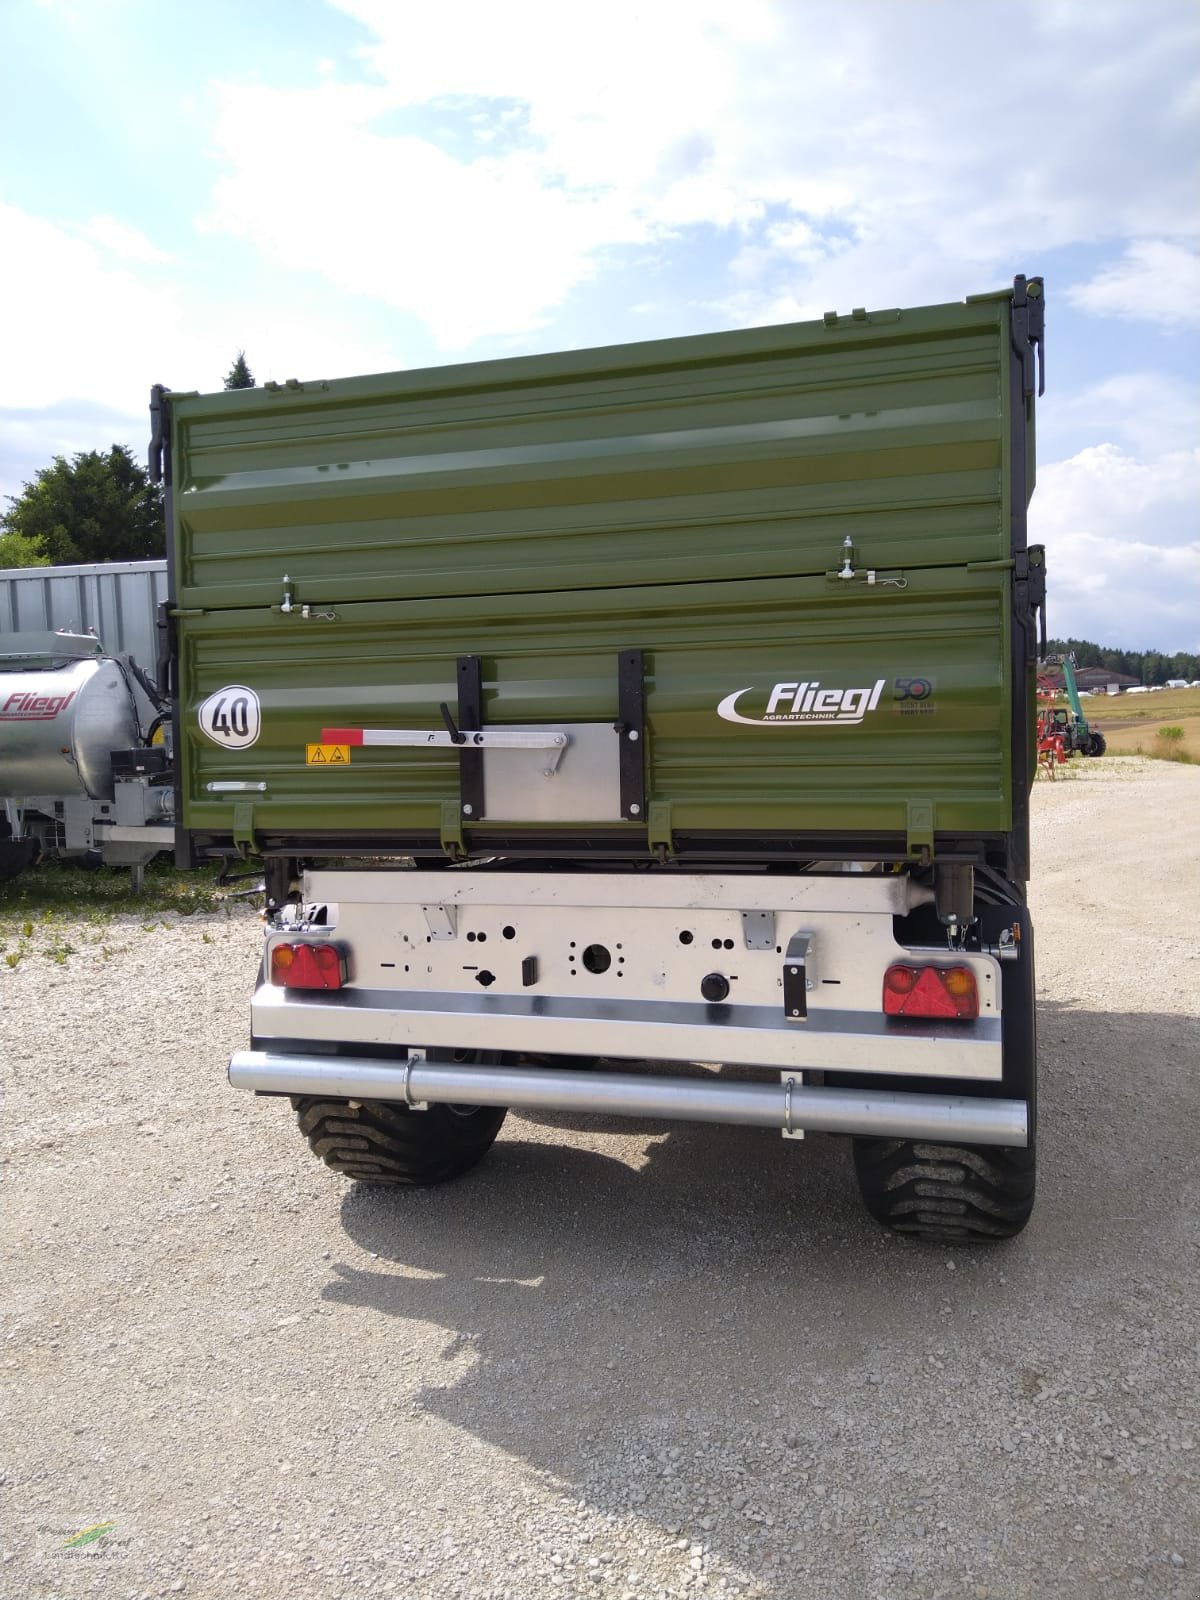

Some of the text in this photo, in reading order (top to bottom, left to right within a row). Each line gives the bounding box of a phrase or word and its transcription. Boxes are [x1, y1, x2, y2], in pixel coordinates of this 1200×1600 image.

[2, 690, 76, 716] Fliegl
[765, 679, 886, 719] Fliegl
[211, 696, 250, 737] 40
[762, 712, 837, 721] AGRARTECHNIK
